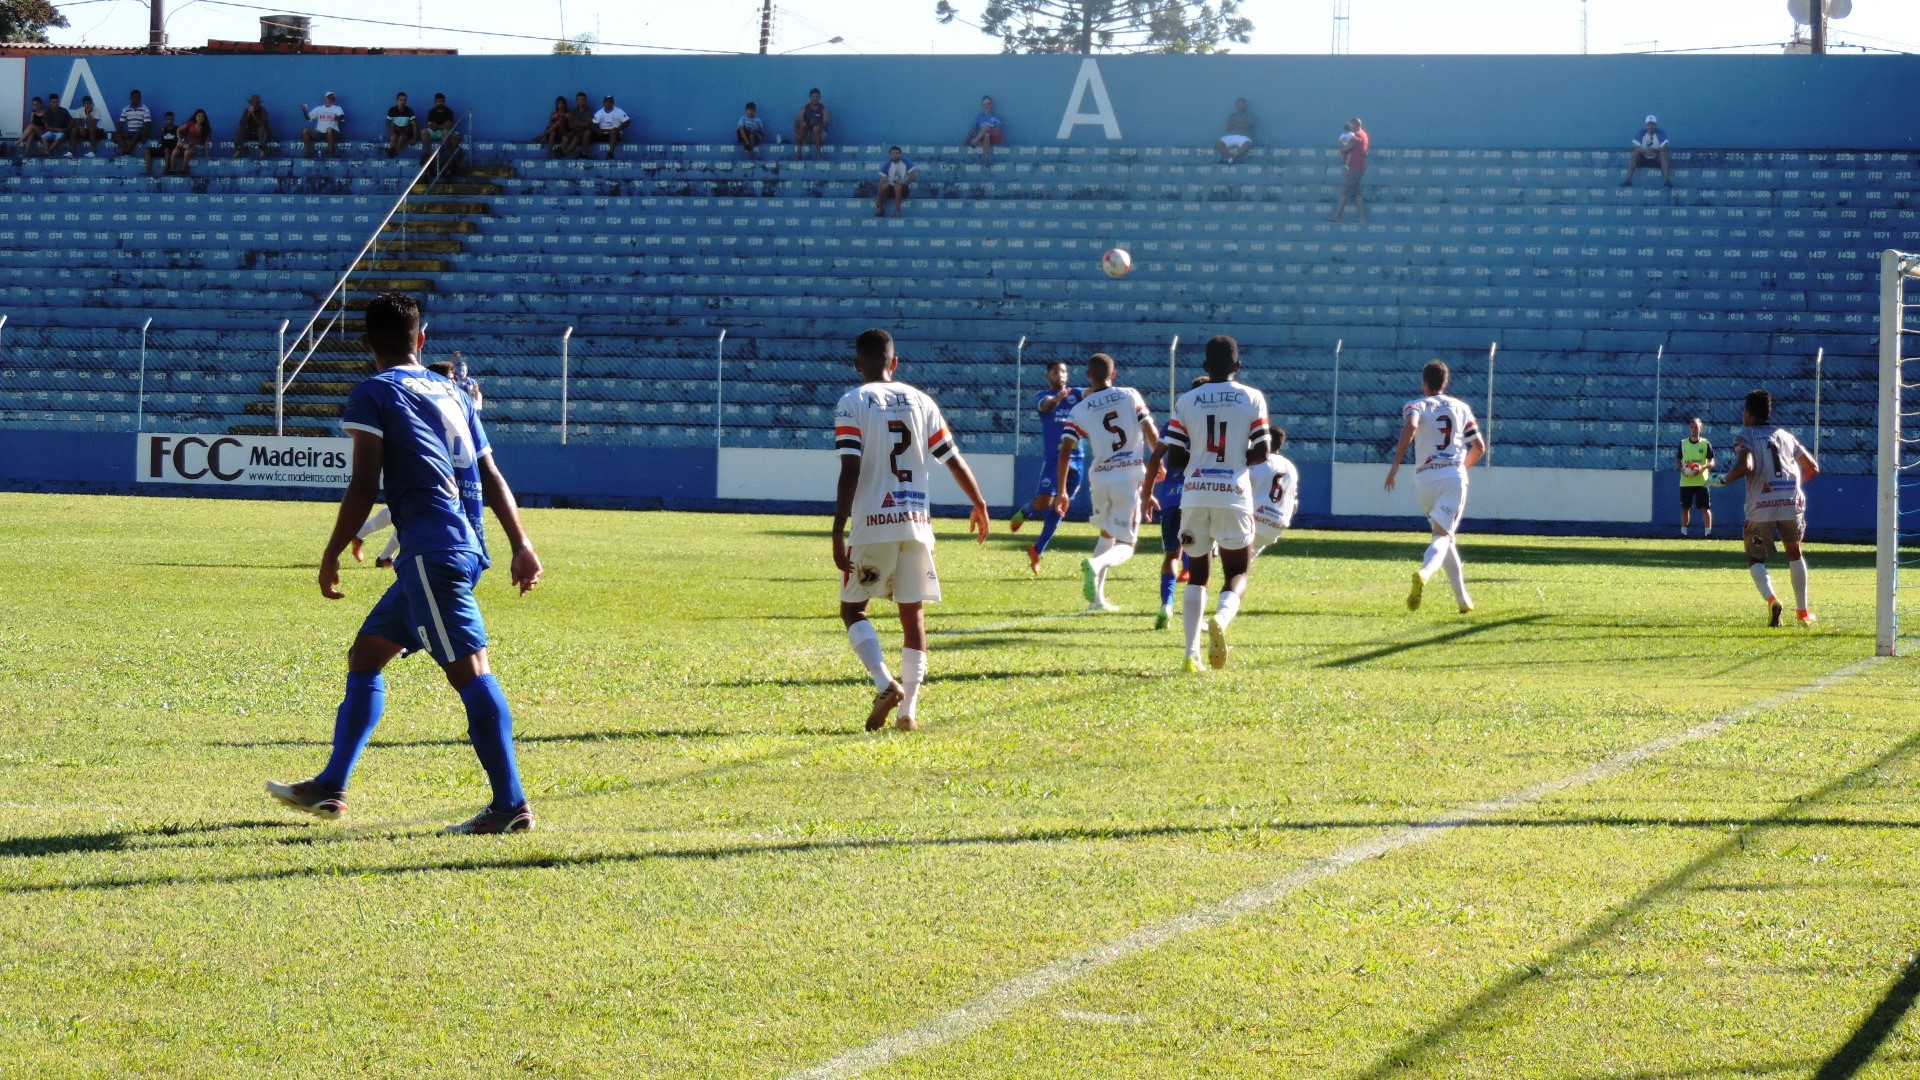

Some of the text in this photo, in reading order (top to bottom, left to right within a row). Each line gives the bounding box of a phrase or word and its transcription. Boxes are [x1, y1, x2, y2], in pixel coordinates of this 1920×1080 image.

[60, 58, 117, 132] A
[1056, 58, 1122, 139] A
[1194, 391, 1243, 406] ALLTEC
[888, 419, 913, 483] 2
[1103, 410, 1127, 452] 5
[1207, 415, 1227, 462] 4
[1436, 415, 1453, 451] 3
[150, 436, 347, 481] FCC Madeiras
[1766, 440, 1783, 478] 1
[1269, 472, 1287, 503] 6
